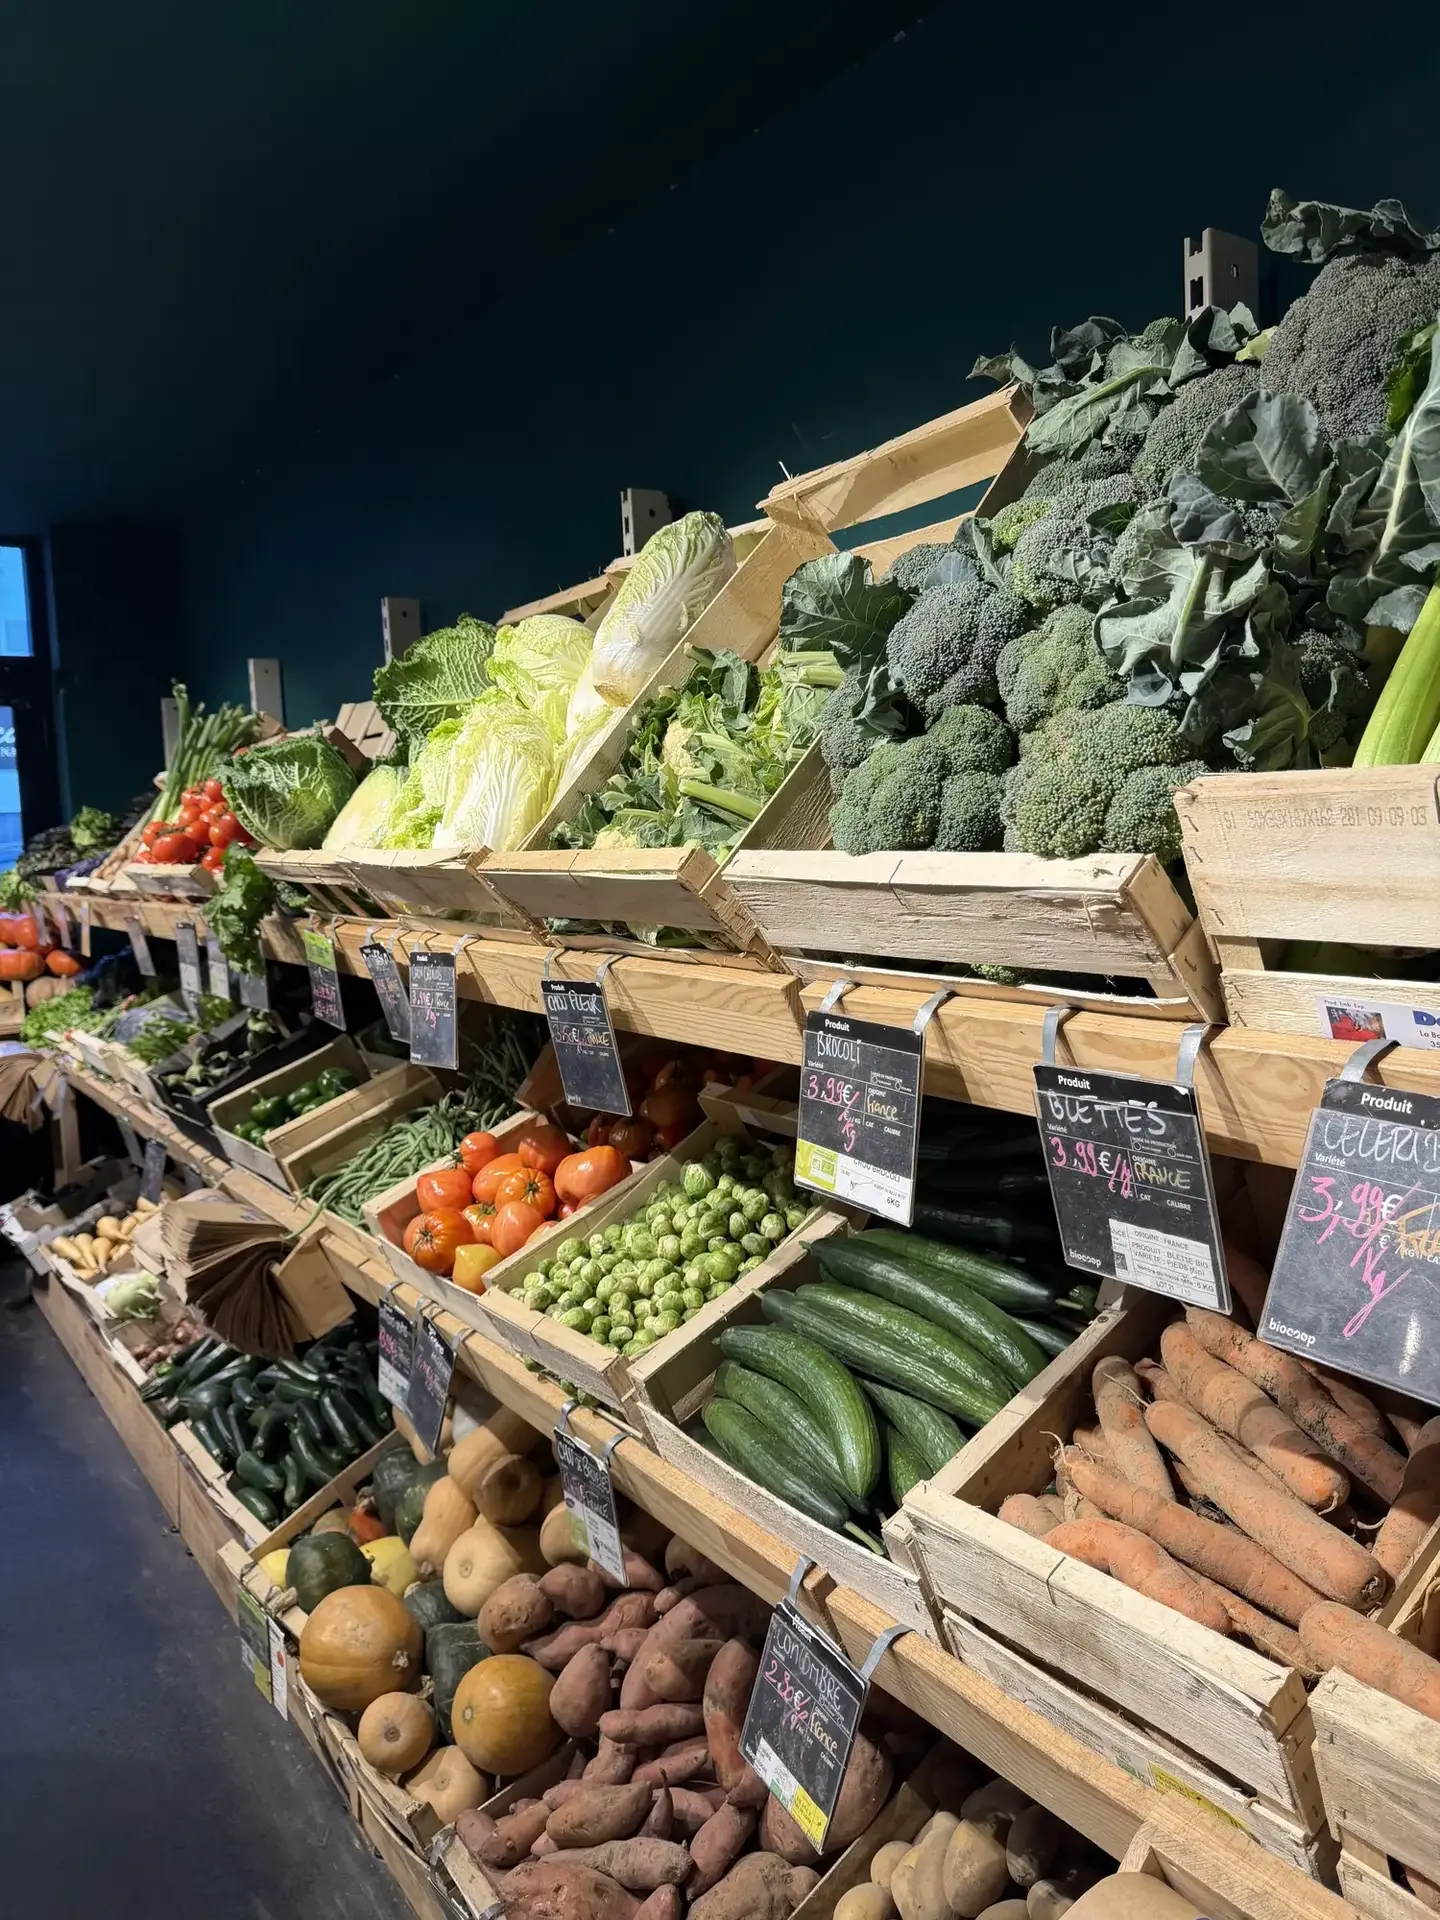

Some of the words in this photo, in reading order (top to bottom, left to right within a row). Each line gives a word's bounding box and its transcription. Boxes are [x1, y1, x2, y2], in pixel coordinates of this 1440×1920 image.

[825, 1018, 850, 1032] Produit
[1058, 1075, 1091, 1090] Produit
[1360, 1092, 1413, 1114] Produit
[1315, 1152, 1346, 1167] Variété
[1166, 1199, 1191, 1211] CALIBRE
[1069, 1247, 1102, 1268] biocoop
[1269, 1317, 1316, 1347] biocoop
